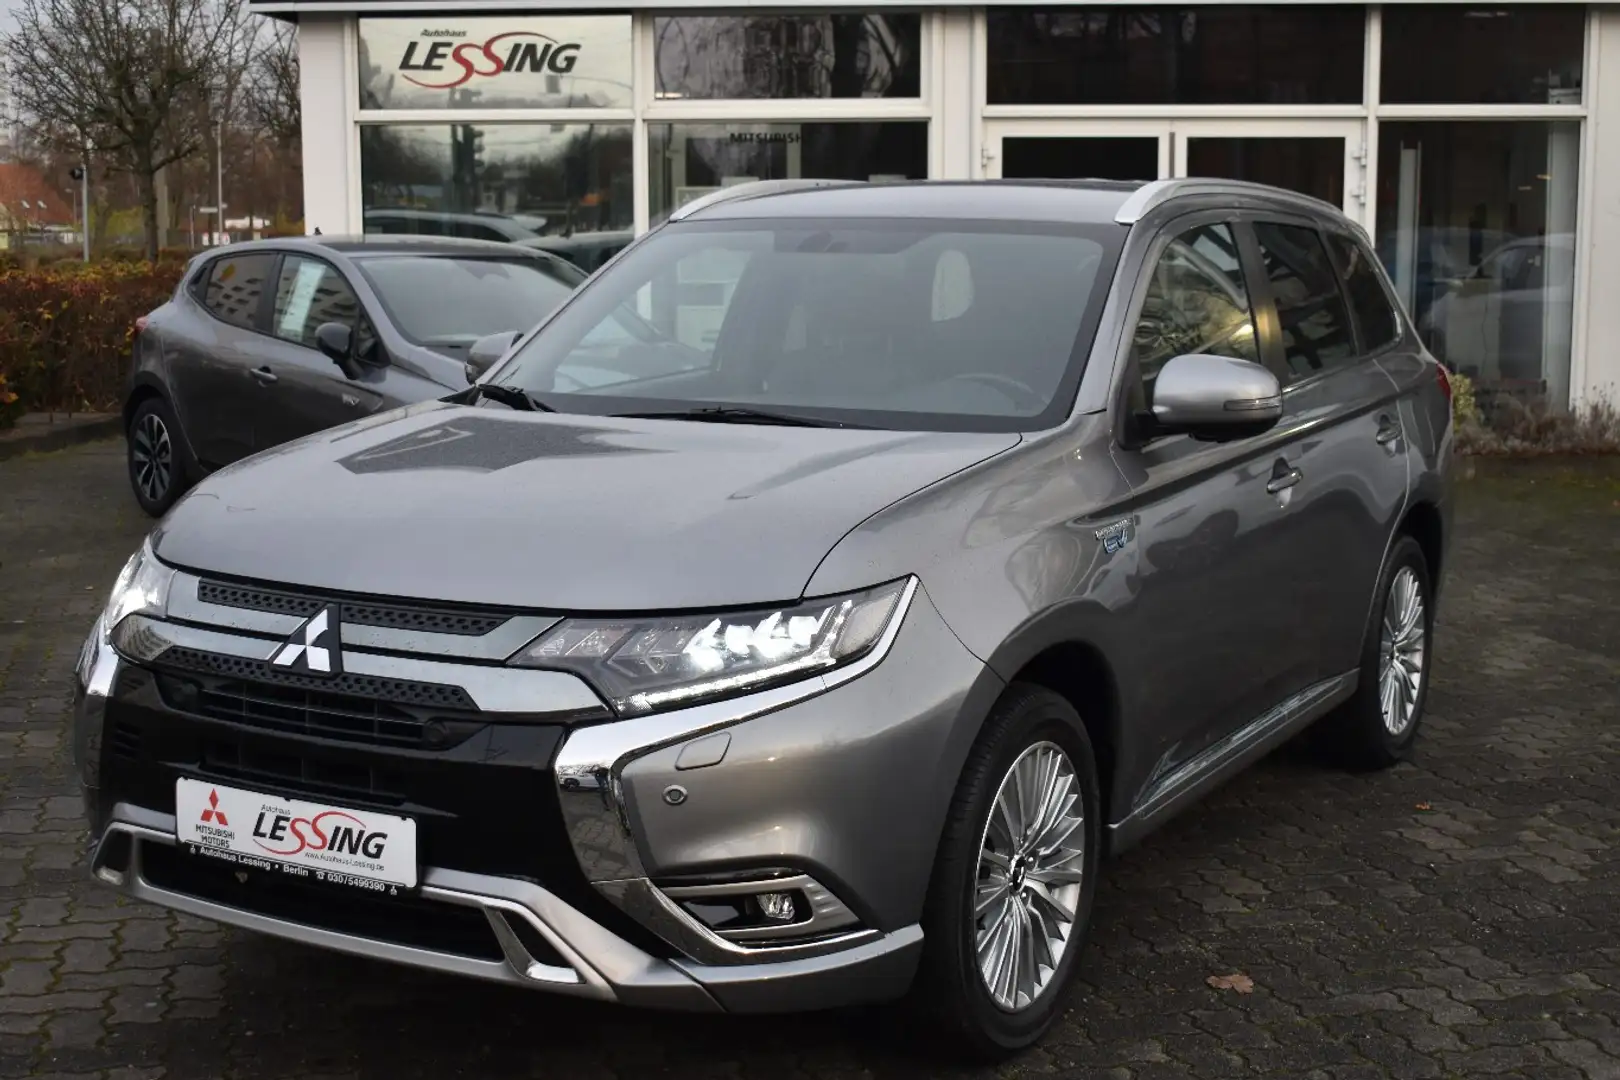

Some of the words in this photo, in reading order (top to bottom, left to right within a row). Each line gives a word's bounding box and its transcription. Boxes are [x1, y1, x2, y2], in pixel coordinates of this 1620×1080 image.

[420, 29, 467, 38] Autohaus
[398, 31, 582, 89] LESSING
[260, 803, 291, 816] Autohaus
[195, 823, 236, 841] MITSUBISHI
[252, 810, 388, 860] LESSING
[201, 834, 231, 849] MOTORS
[199, 846, 238, 862] Autohaus
[238, 854, 272, 872] Lessing
[283, 863, 310, 878] Berlin
